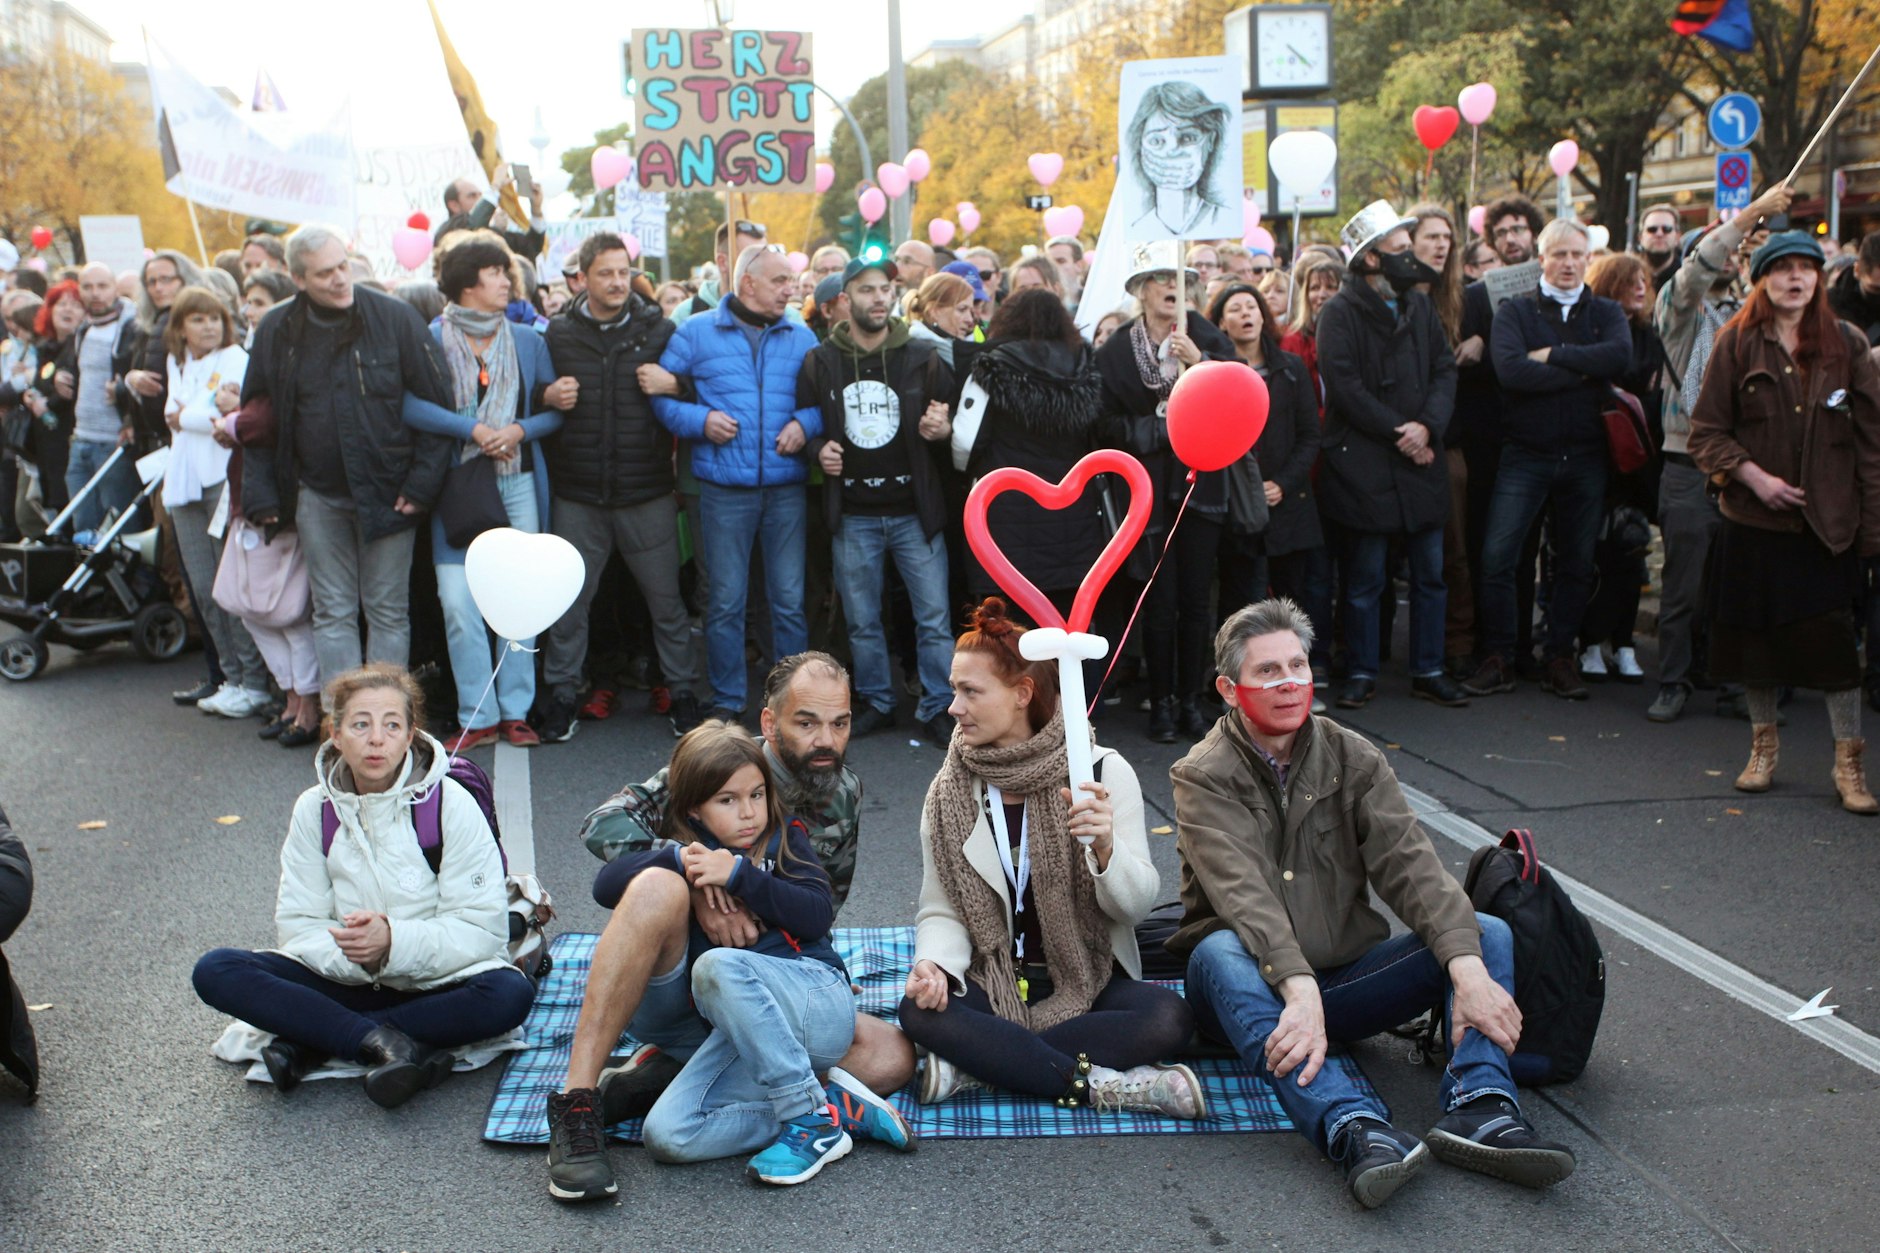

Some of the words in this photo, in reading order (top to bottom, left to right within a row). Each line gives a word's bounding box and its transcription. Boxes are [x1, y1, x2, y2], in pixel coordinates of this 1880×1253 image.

[644, 29, 811, 78] HERZ
[642, 76, 816, 131] STATT
[637, 130, 816, 188] ANGST
